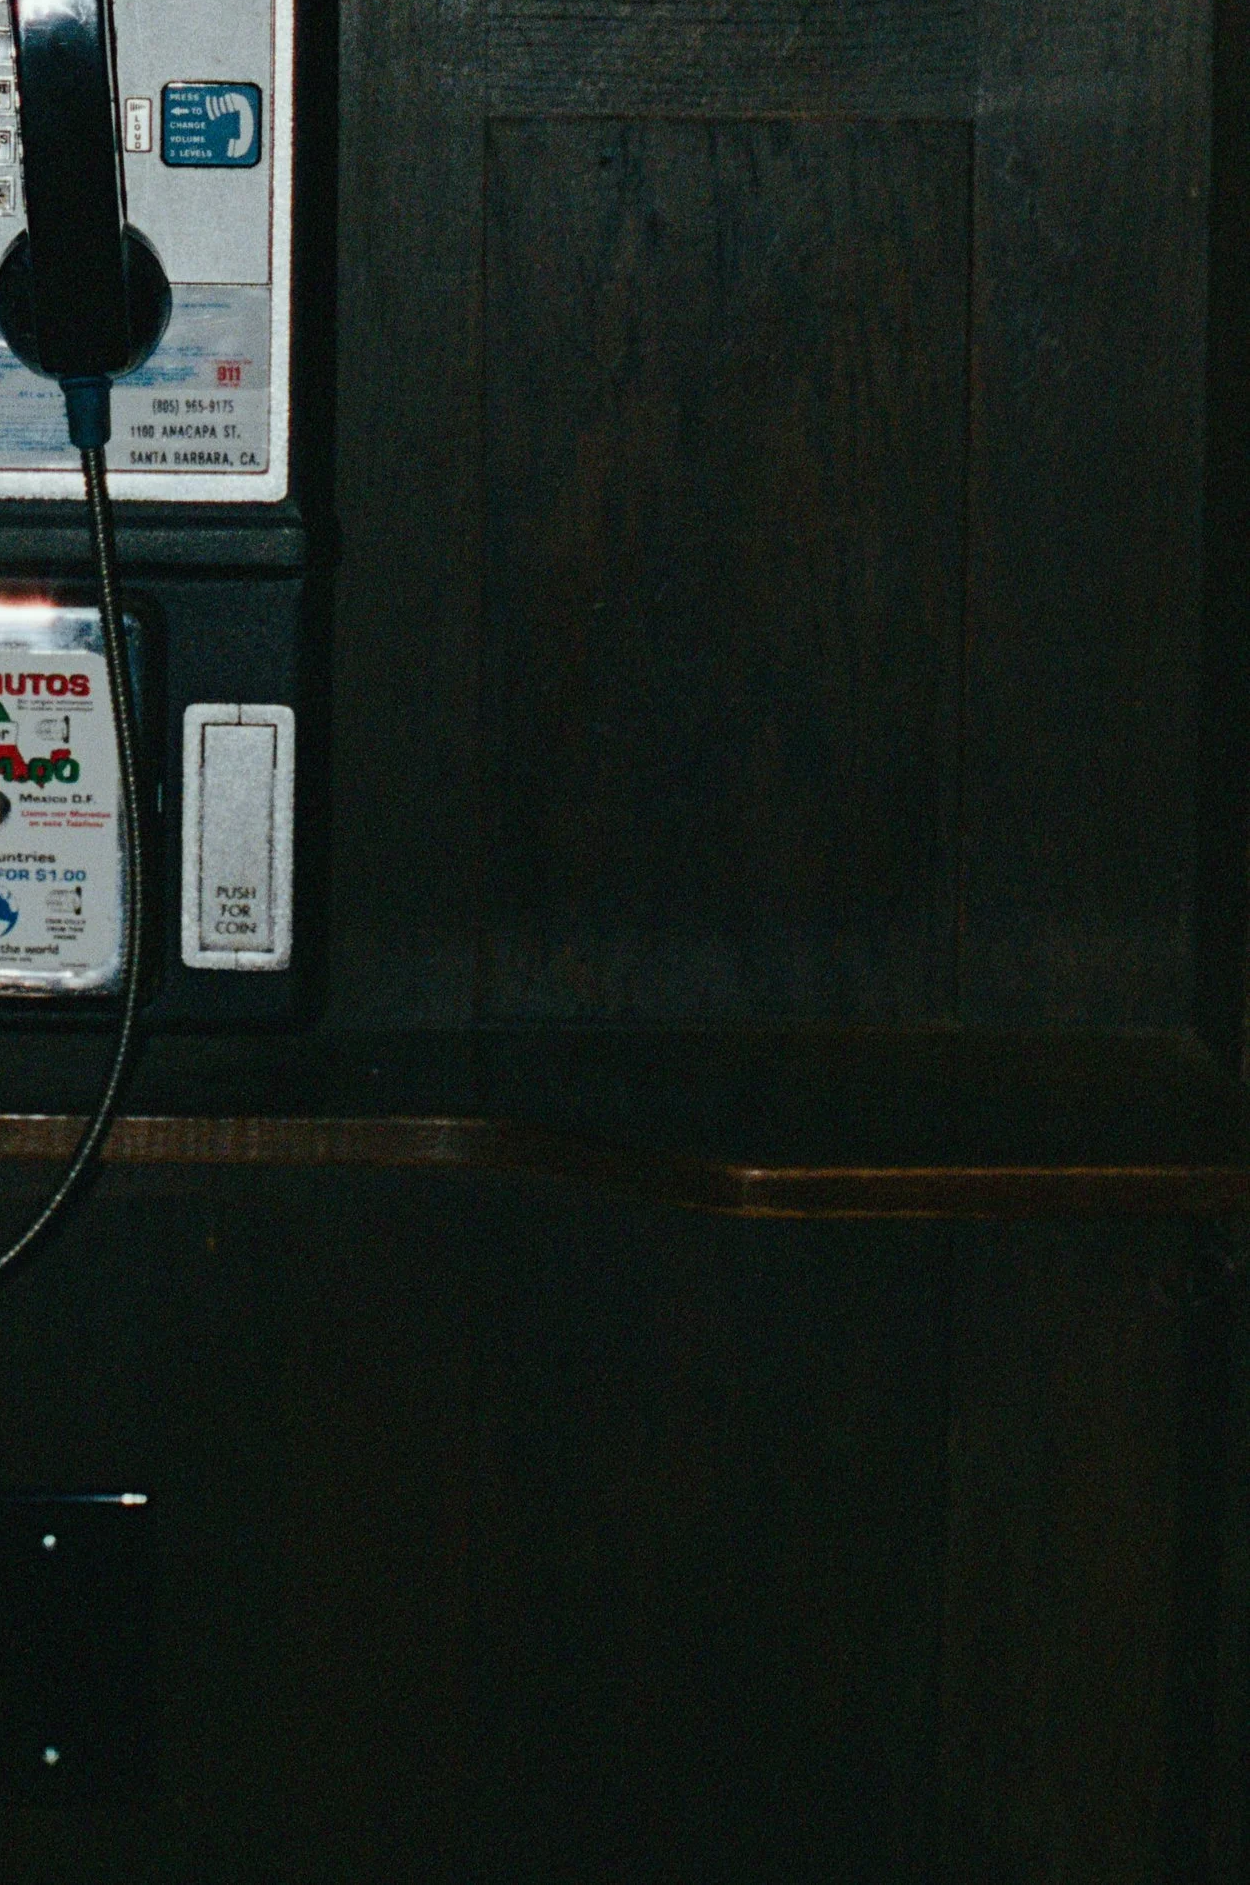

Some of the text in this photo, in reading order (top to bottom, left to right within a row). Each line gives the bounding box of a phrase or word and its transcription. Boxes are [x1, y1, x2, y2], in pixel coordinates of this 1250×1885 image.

[169, 93, 200, 101] PRESS
[191, 106, 203, 115] TO
[169, 121, 206, 130] CHANGE
[170, 135, 206, 143] VOLUME
[179, 149, 213, 157] LEVELS
[152, 398, 180, 415] (805)
[161, 424, 217, 439] ANACAPA
[223, 425, 241, 438] ST.
[130, 451, 260, 466] SANTA BARBARA, CA.
[19, 793, 67, 803] Mexico
[35, 868, 87, 883] $1.00
[216, 886, 257, 900] PUSH
[221, 904, 250, 917] FOR
[215, 921, 257, 935] COIN
[0, 943, 21, 955] the
[25, 944, 59, 956] world
